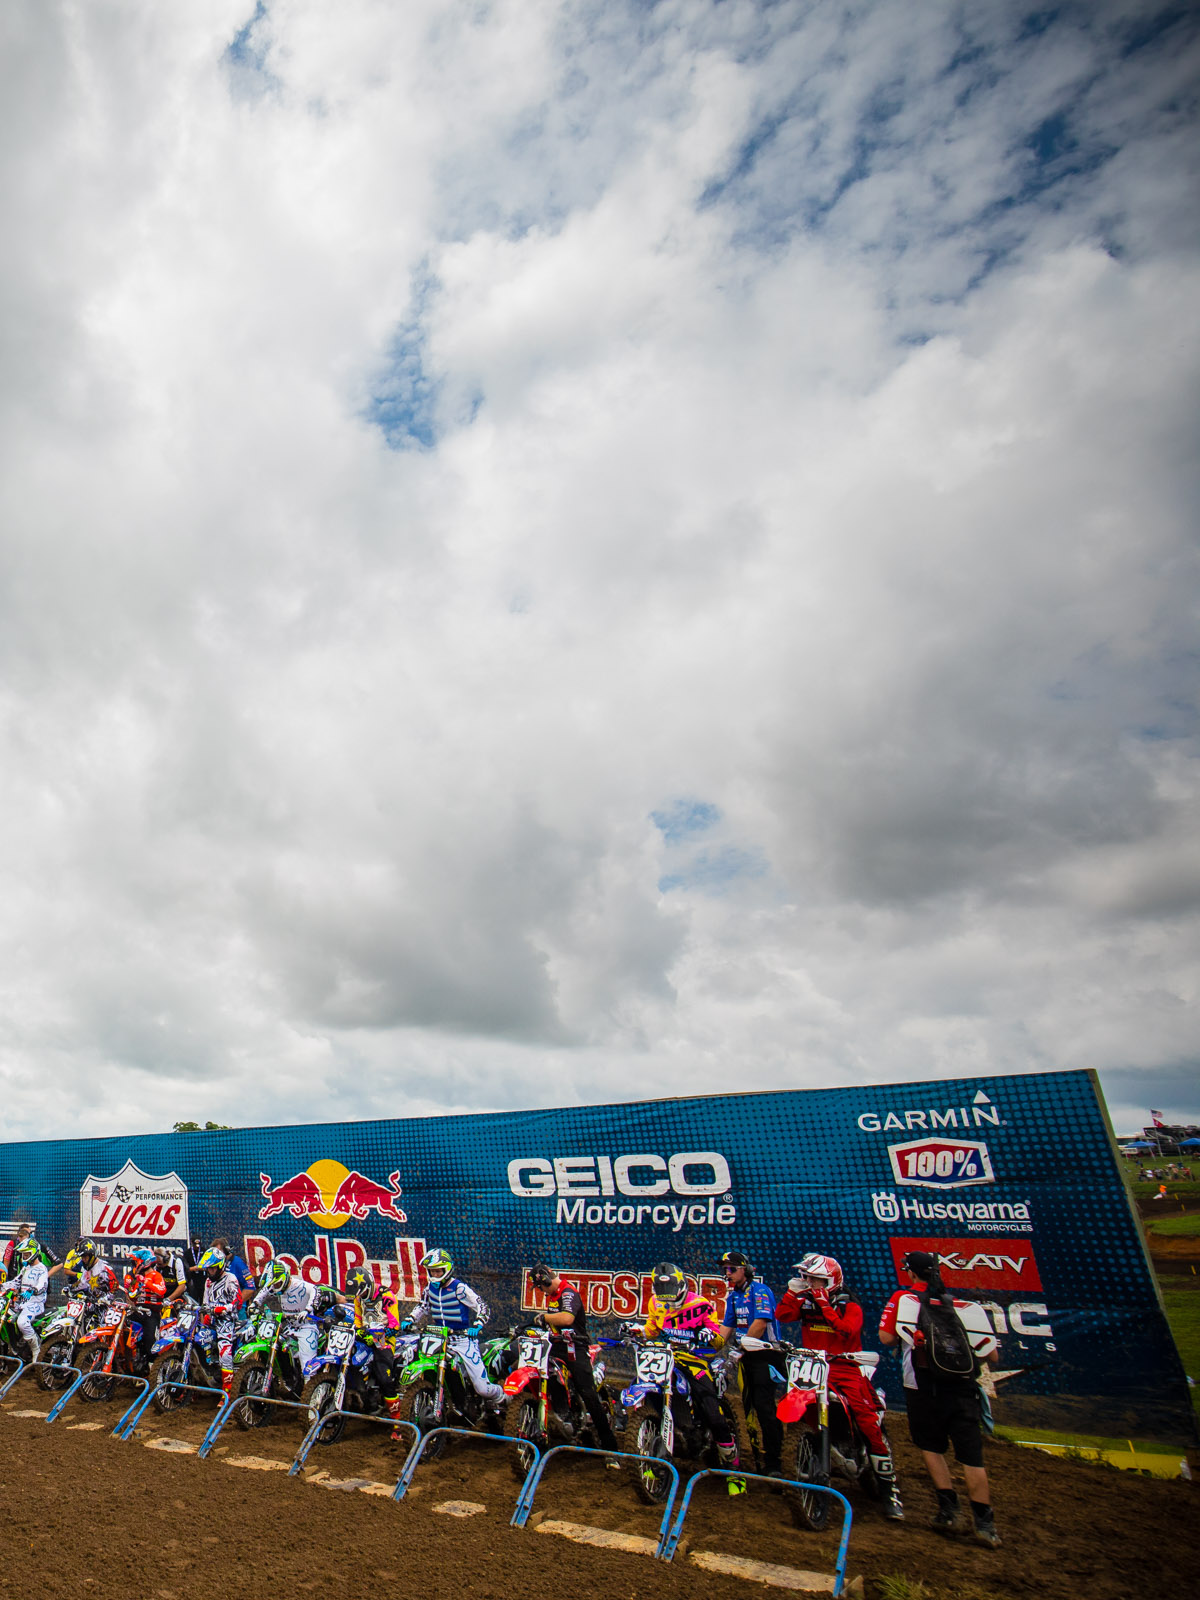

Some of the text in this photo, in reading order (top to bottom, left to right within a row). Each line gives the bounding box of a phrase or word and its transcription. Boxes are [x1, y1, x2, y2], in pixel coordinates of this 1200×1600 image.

[858, 1106, 1000, 1132] GARMIN
[904, 1150, 977, 1177] 100%
[507, 1151, 731, 1197] GEICO
[135, 1193, 183, 1201] PERFORMANCE
[93, 1204, 181, 1236] LUCAS
[555, 1198, 736, 1232] Motorcycle
[902, 1198, 1031, 1223] Husqvarna
[967, 1223, 1034, 1232] MOTORCYCLES
[964, 1253, 1030, 1274] ATV
[67, 1302, 82, 1316] 16
[105, 1310, 122, 1324] 26
[177, 1314, 193, 1329] 74
[258, 1321, 275, 1338] 46
[329, 1330, 349, 1349] 39
[669, 1329, 695, 1339] YAMAHA
[421, 1336, 443, 1356] 17
[521, 1341, 542, 1361] 31
[637, 1352, 668, 1373] 23
[789, 1359, 826, 1385] 640
